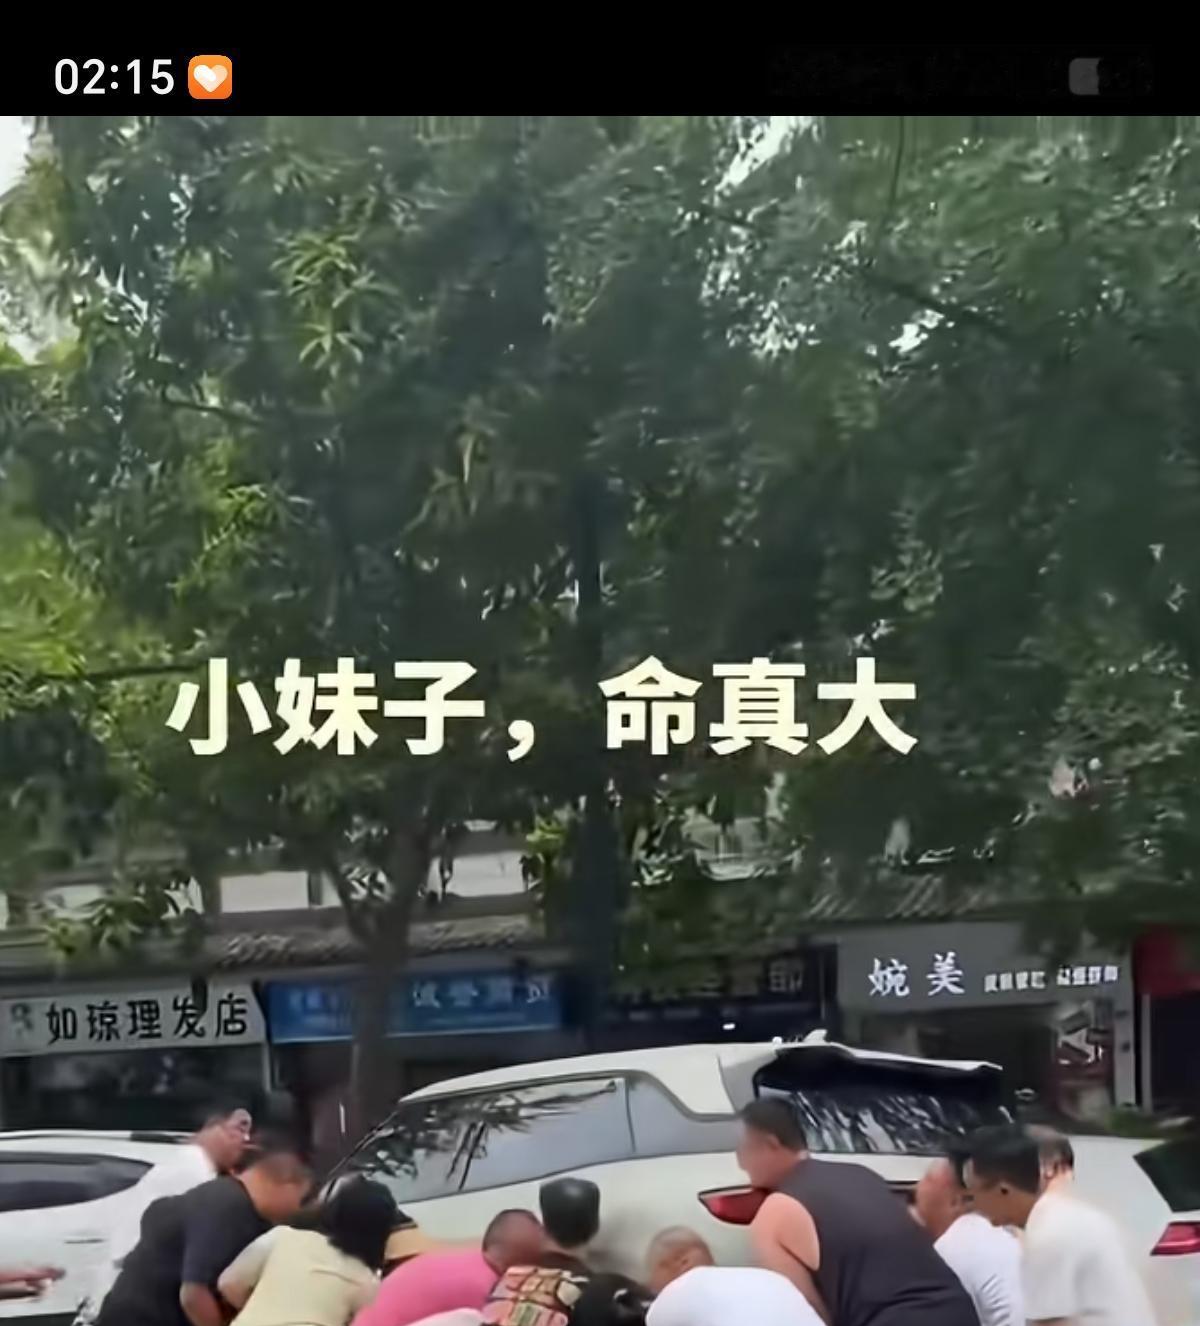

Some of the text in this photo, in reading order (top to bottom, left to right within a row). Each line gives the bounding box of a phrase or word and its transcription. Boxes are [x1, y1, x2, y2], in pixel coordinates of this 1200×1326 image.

[46, 992, 248, 1045] 如琼理发店
